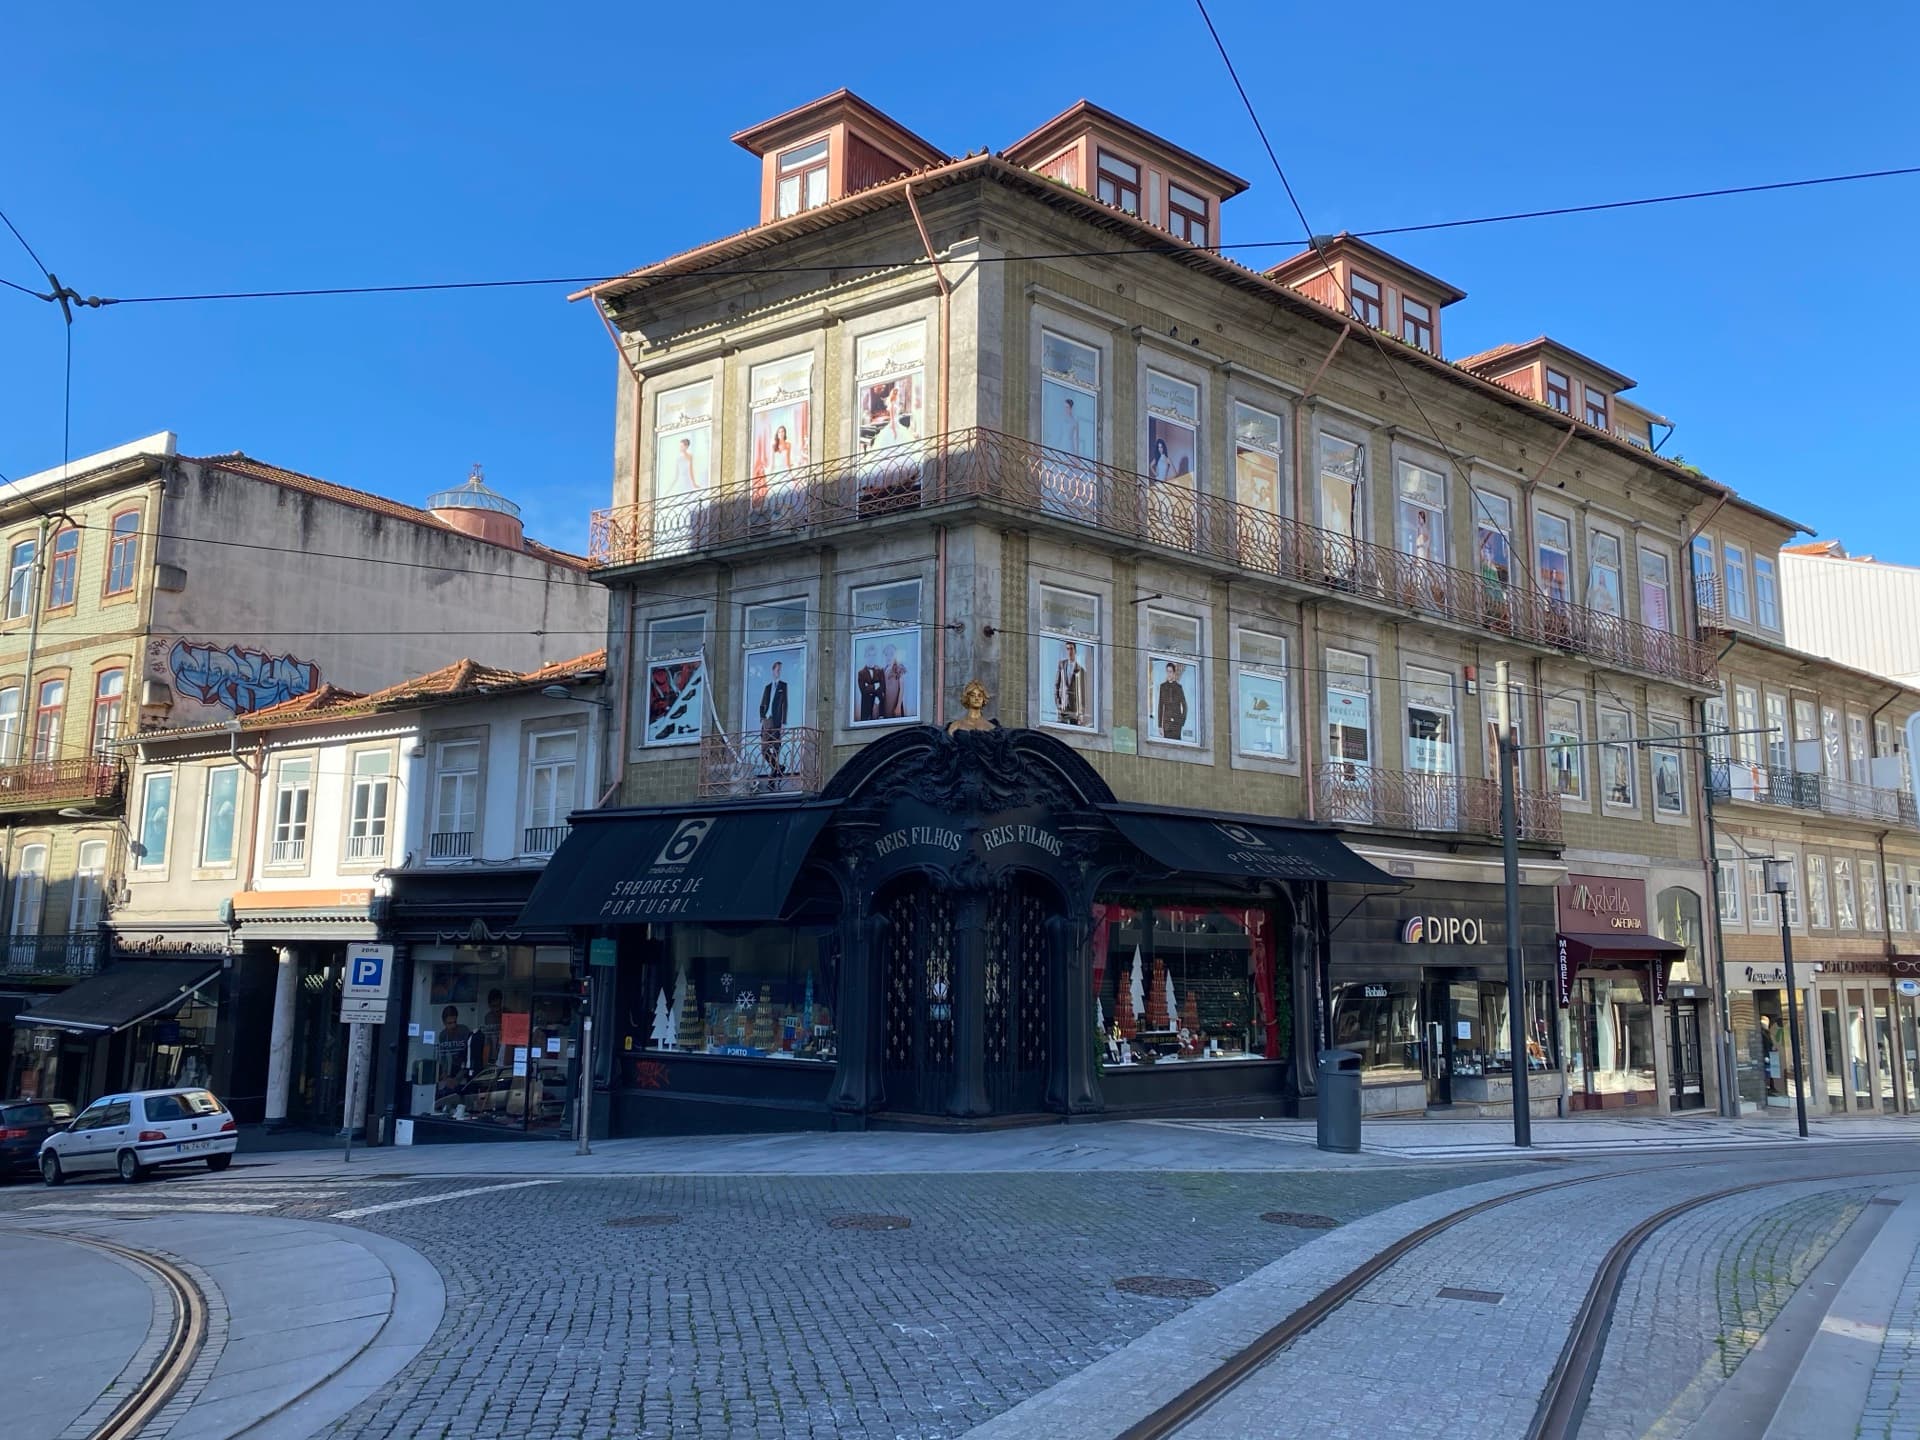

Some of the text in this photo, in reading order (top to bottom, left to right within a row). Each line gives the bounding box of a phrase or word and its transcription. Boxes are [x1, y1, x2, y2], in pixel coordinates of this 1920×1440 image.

[911, 826, 962, 851] FILHOS
[1018, 824, 1063, 857] FILHOS
[611, 877, 705, 896] SABORES DE
[599, 898, 691, 916] PORTUGAL
[1428, 916, 1488, 945] DIPOL
[358, 961, 377, 983] P
[1559, 940, 1569, 1004] MARBELLA
[727, 1047, 748, 1056] PORTO
